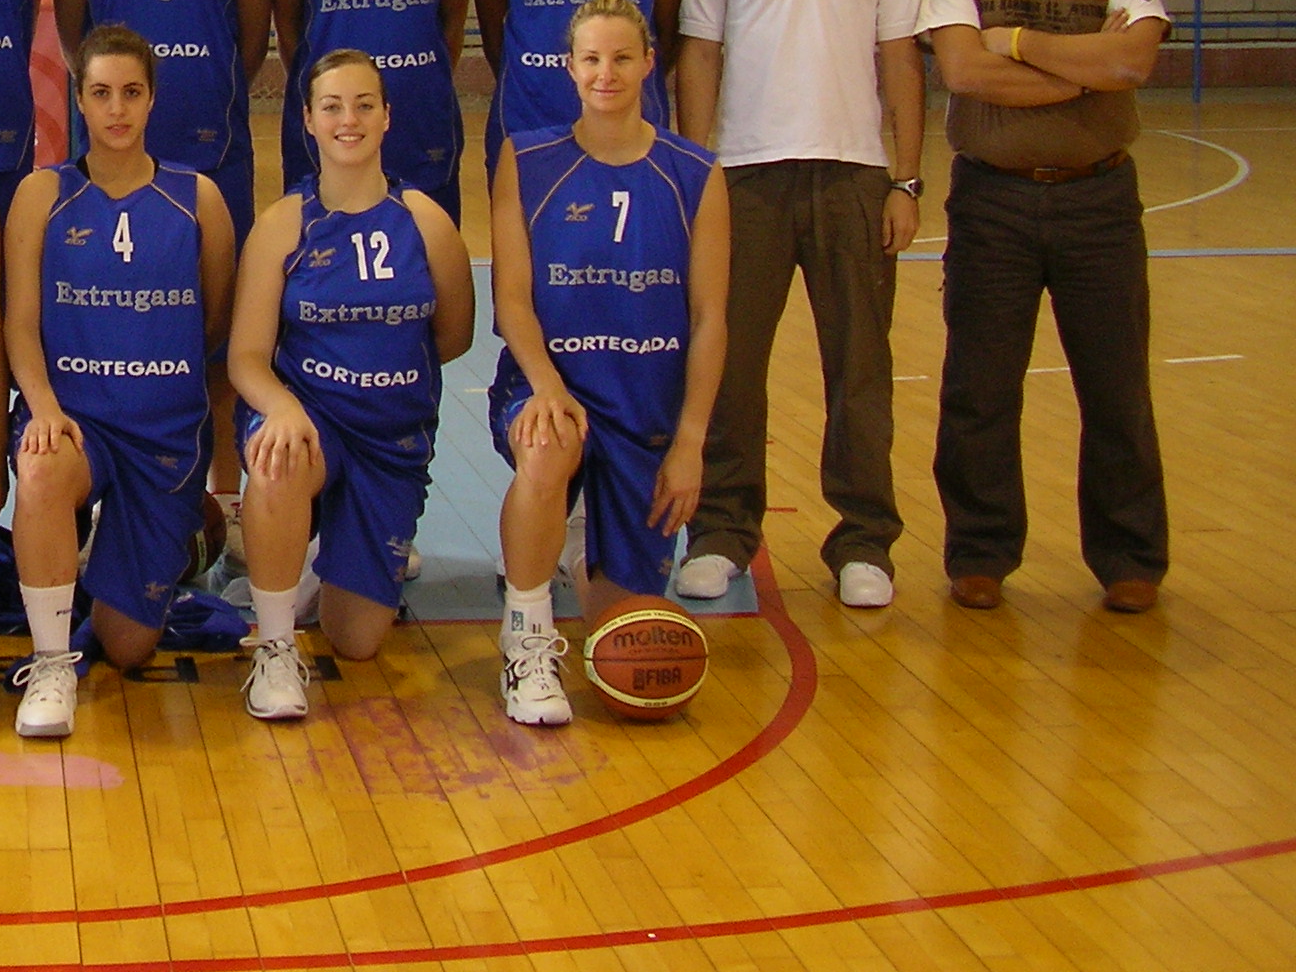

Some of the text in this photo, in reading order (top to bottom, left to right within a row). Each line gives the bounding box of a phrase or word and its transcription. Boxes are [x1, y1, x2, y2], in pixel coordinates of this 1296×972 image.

[370, 49, 438, 70] EGADA
[612, 191, 631, 243] 7
[112, 211, 135, 263] 4
[351, 230, 395, 281] 12
[547, 263, 681, 293] Extrugas
[55, 280, 196, 313] Extrugasa
[298, 300, 436, 326] Extrugas
[548, 335, 680, 355] CORTEGADA
[56, 355, 190, 377] CORTEGADA
[302, 357, 419, 388] CORTEGAD
[613, 626, 693, 648] molten
[646, 667, 682, 687] FIBA
